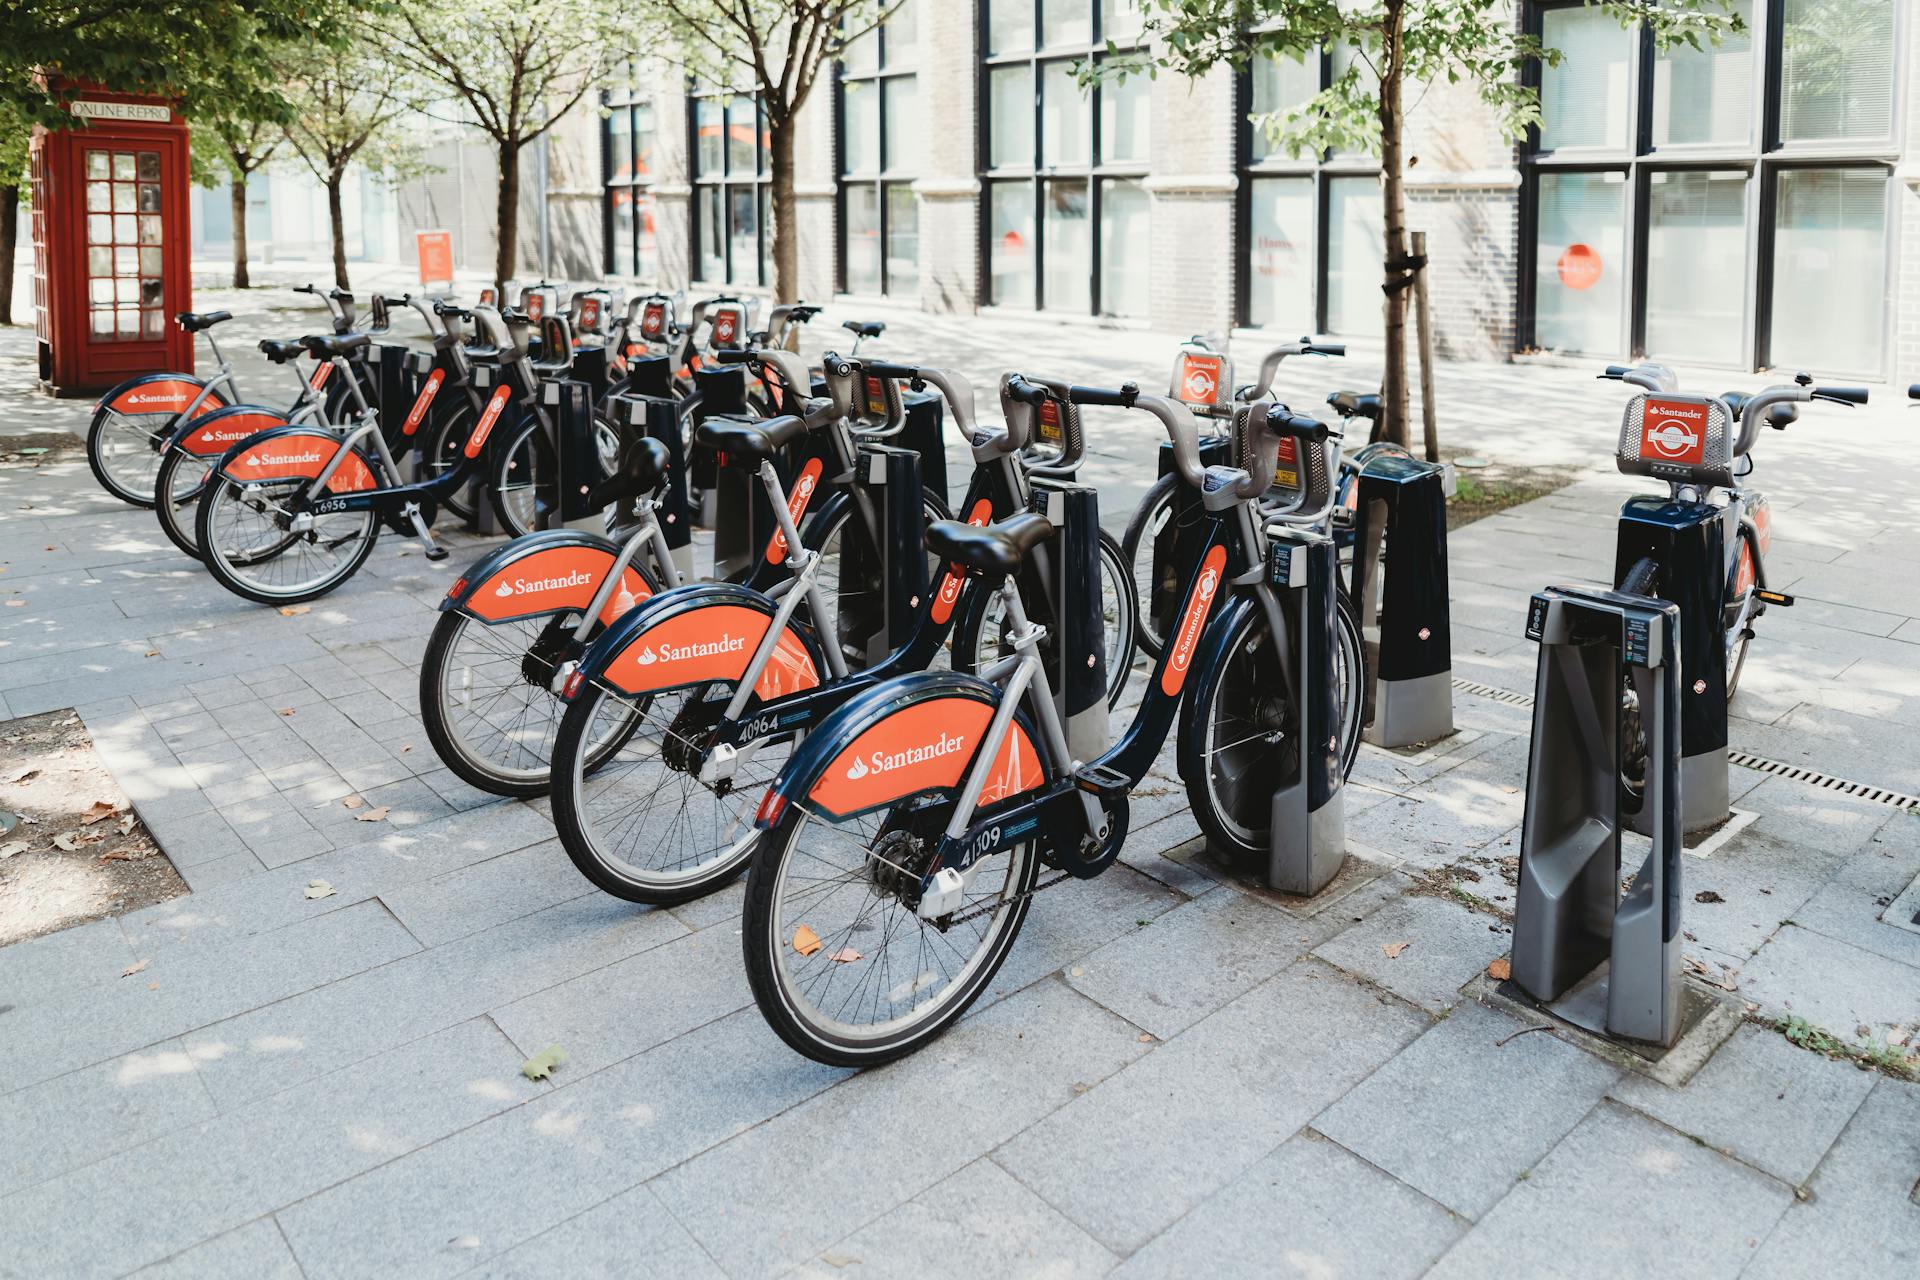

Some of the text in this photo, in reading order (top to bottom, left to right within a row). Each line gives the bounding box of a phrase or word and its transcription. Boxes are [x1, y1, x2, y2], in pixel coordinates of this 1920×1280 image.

[73, 103, 169, 119] ONLINE REPRO
[139, 391, 188, 404] Santander
[1659, 407, 1703, 419] Santander
[260, 450, 322, 466] Santander
[515, 570, 592, 596] Santander
[1181, 602, 1205, 653] Santander
[659, 633, 745, 664] Santander
[738, 715, 779, 743] 40964
[871, 732, 965, 776] Santander
[959, 825, 1001, 867] 41309
